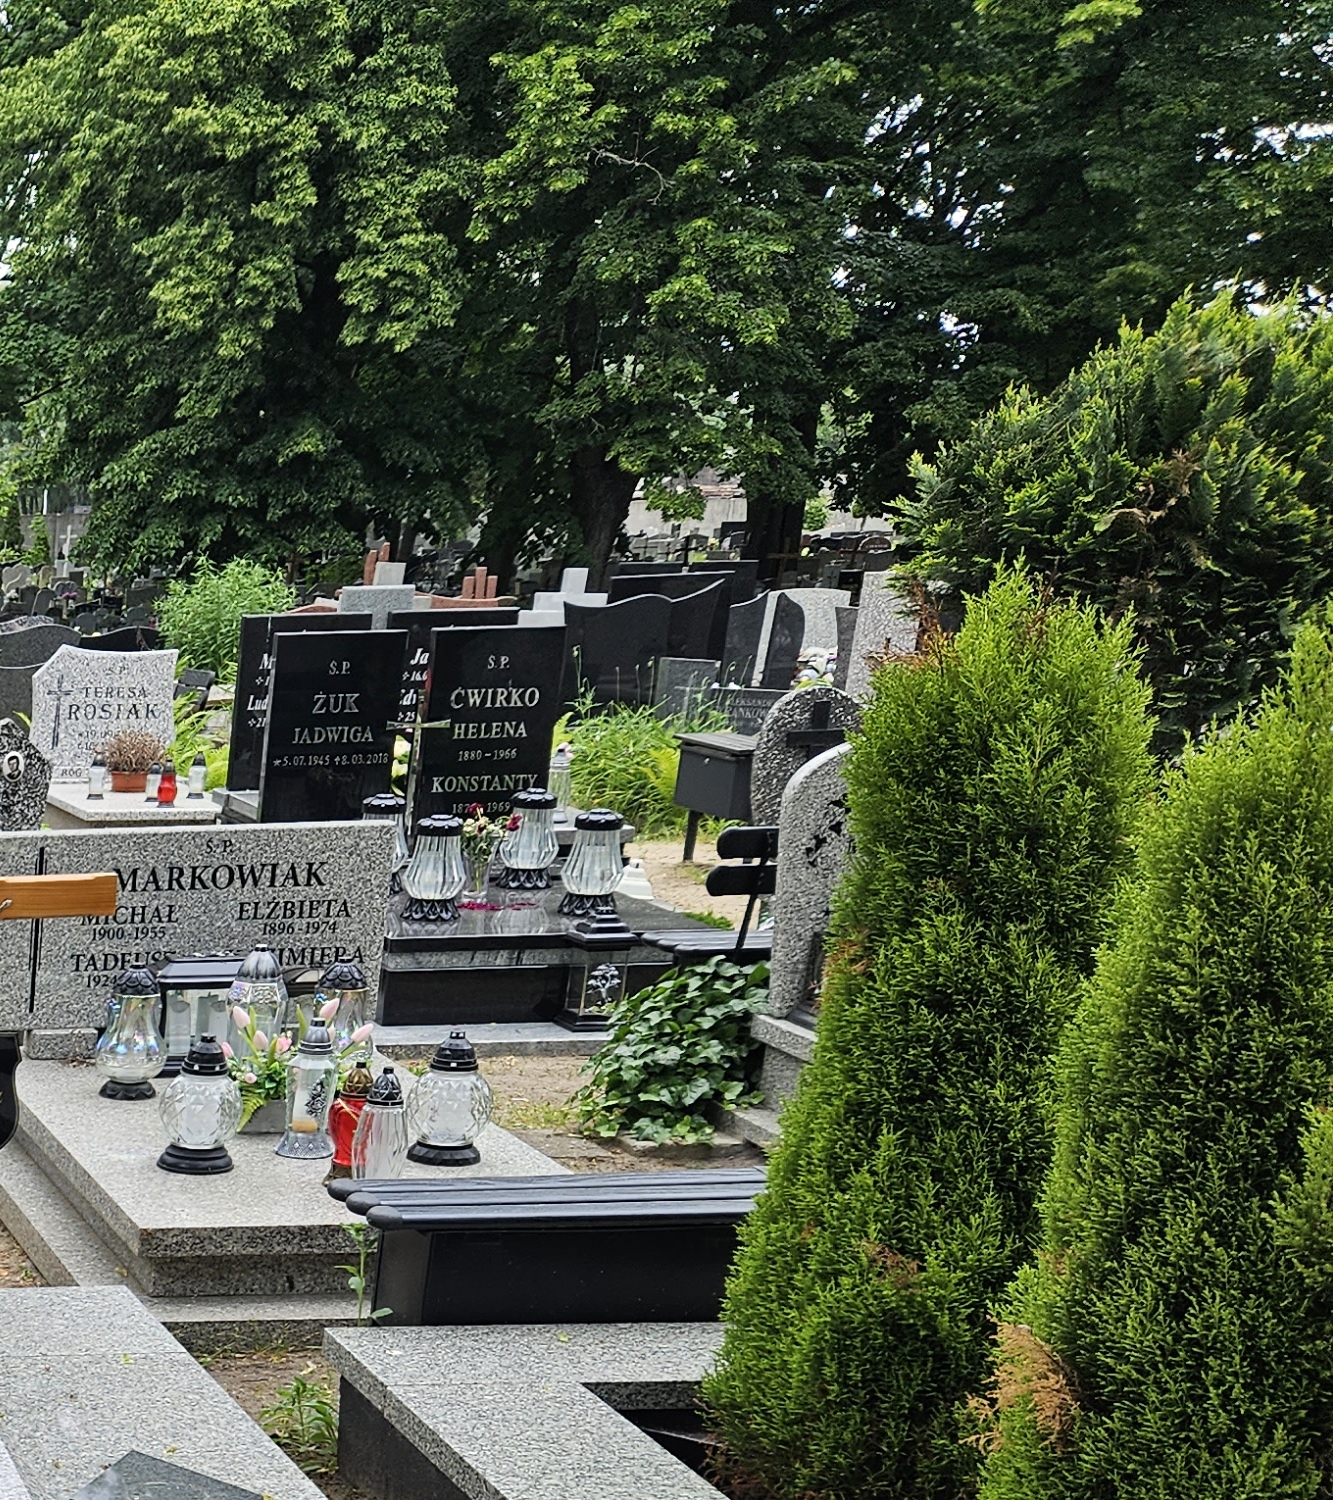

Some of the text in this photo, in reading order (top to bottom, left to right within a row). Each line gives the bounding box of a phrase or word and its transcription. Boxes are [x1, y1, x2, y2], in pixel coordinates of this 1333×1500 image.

[83, 687, 148, 698] TERESA
[313, 691, 361, 714] ŻUK
[68, 704, 161, 721] ROSIAK
[292, 726, 374, 745] JADWIGA
[452, 721, 528, 741] HELENA
[431, 774, 538, 793] KONSTANTY
[113, 861, 328, 893] MARKOWIAK
[237, 897, 352, 921] ELŻBIETA
